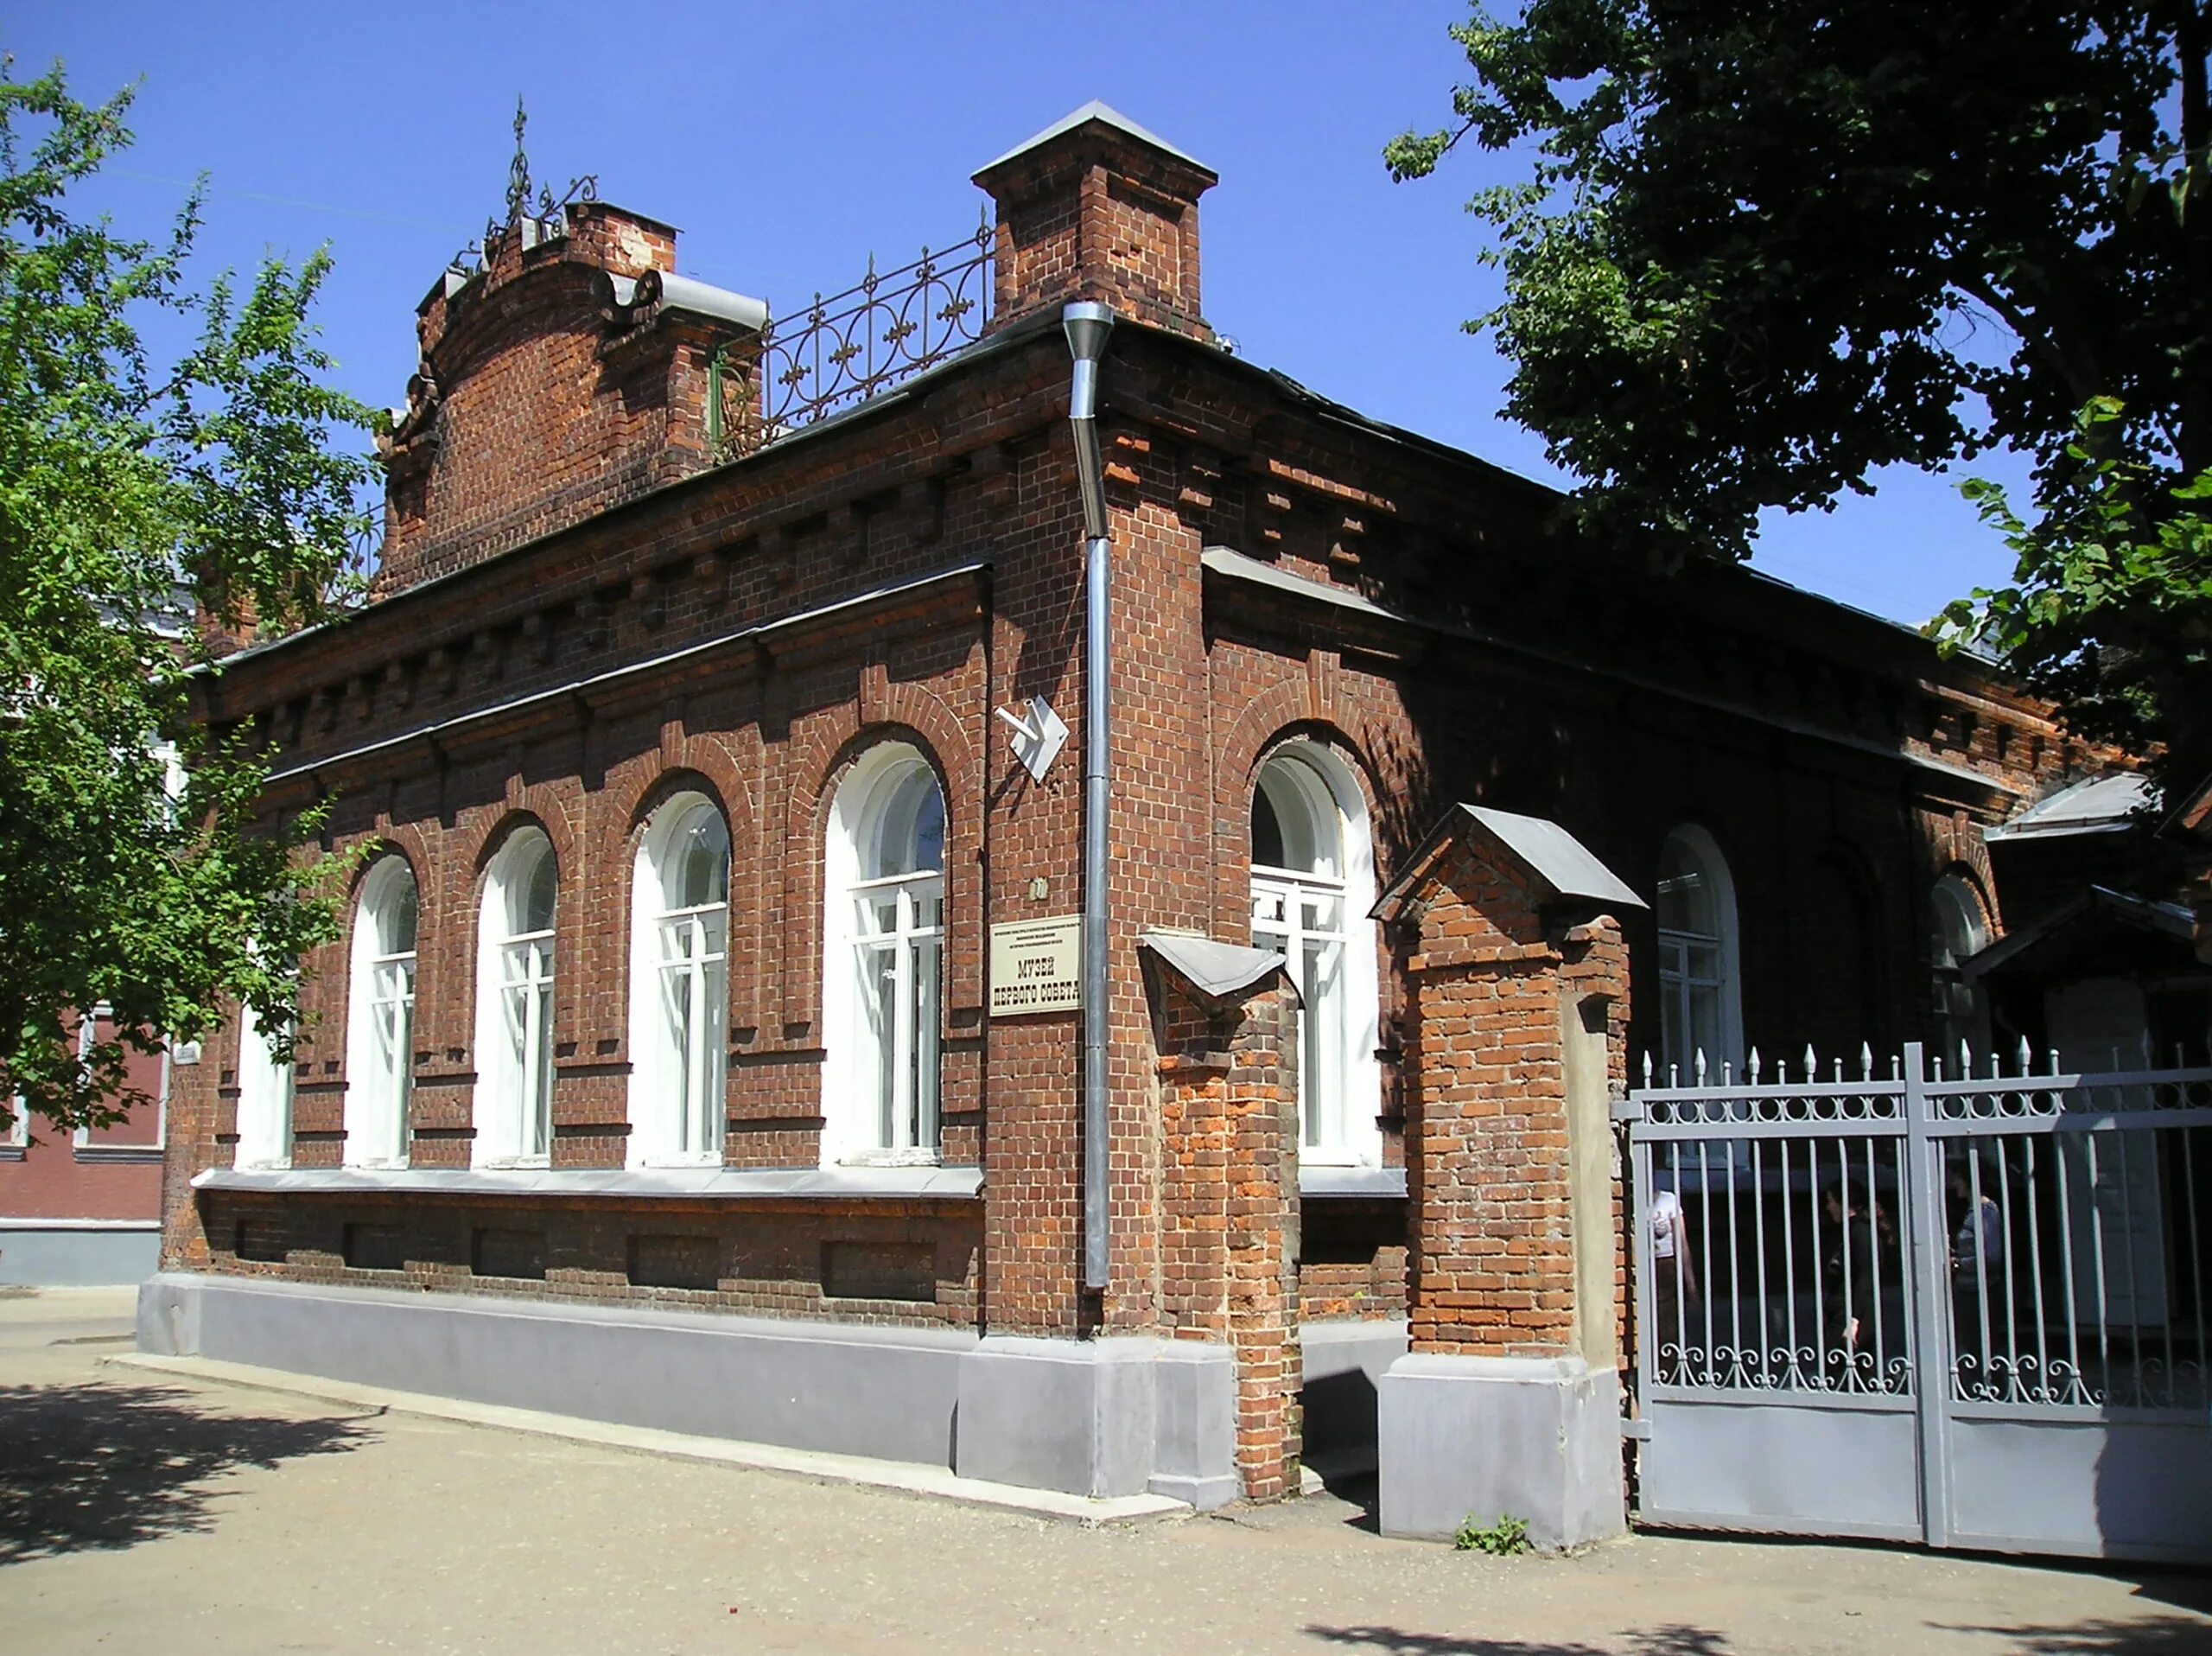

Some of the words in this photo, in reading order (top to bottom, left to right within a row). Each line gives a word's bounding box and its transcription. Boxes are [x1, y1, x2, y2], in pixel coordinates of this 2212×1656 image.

[1018, 956, 1054, 979] МУЗЕЙ
[994, 984, 1037, 1007] ПЕРВОГО
[1040, 980, 1080, 1003] СОВЕТА
